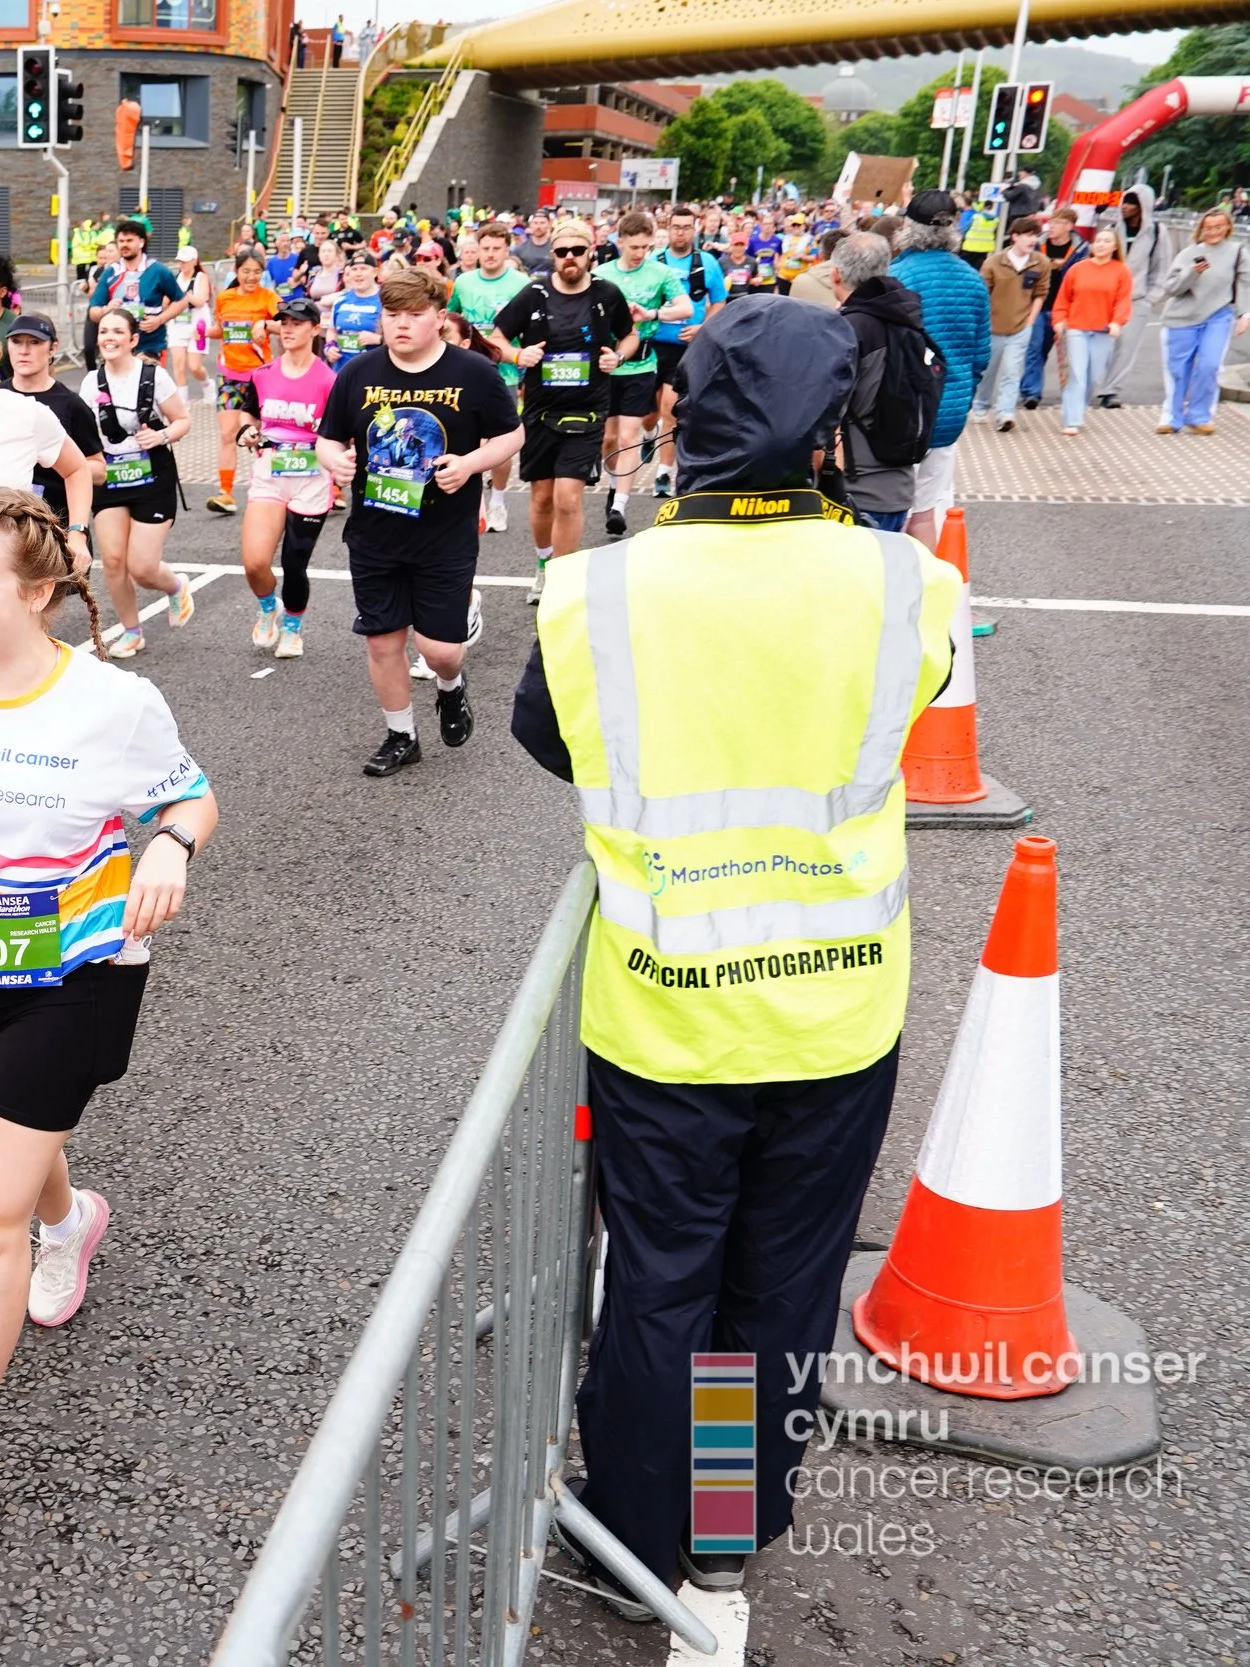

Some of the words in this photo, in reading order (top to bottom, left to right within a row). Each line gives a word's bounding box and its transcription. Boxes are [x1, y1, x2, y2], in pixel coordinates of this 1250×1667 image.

[551, 368, 581, 379] 3336
[361, 386, 464, 411] MEGADETH
[283, 457, 308, 469] 739
[114, 468, 143, 481] 1020
[375, 485, 409, 505] 1454
[730, 498, 790, 516] Nikon
[15, 752, 79, 770] canser
[671, 857, 767, 885] Marathon
[772, 855, 843, 877] Photos
[10, 929, 39, 937] RESEARCH
[39, 927, 57, 935] WALES
[34, 919, 57, 928] CANCER
[627, 947, 710, 989] OFFICIAL
[716, 942, 883, 988] PHOTOGRAPHER
